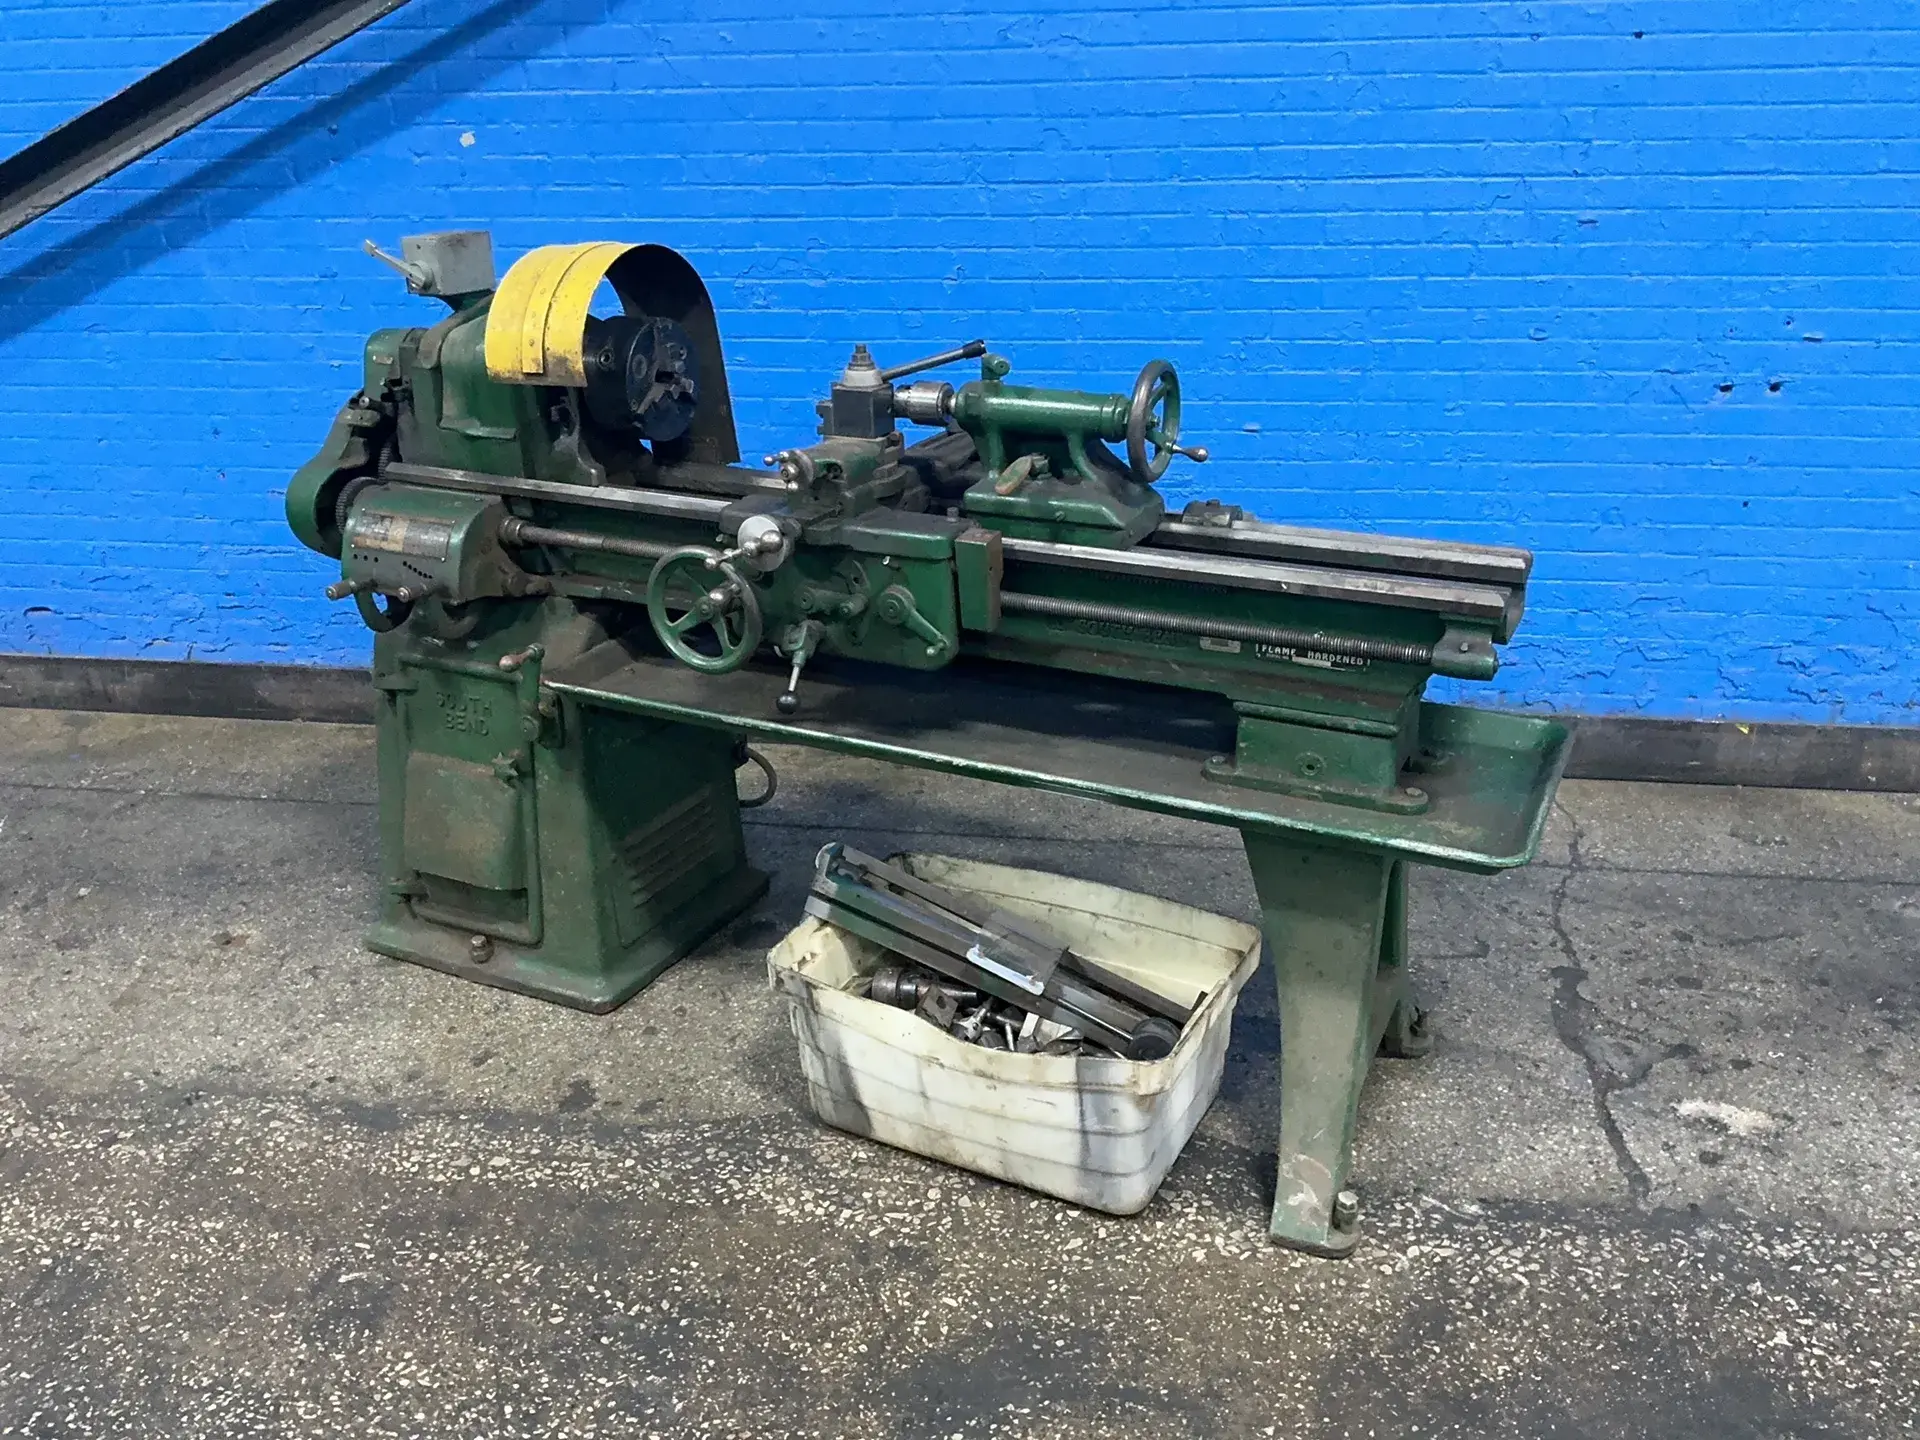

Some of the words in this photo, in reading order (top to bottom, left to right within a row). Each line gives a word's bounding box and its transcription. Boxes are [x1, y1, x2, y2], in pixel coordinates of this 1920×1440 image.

[1261, 644, 1297, 657] FLAME
[1307, 650, 1364, 666] HARDENED
[436, 691, 493, 717] SOUTH
[445, 711, 490, 737] BEND
